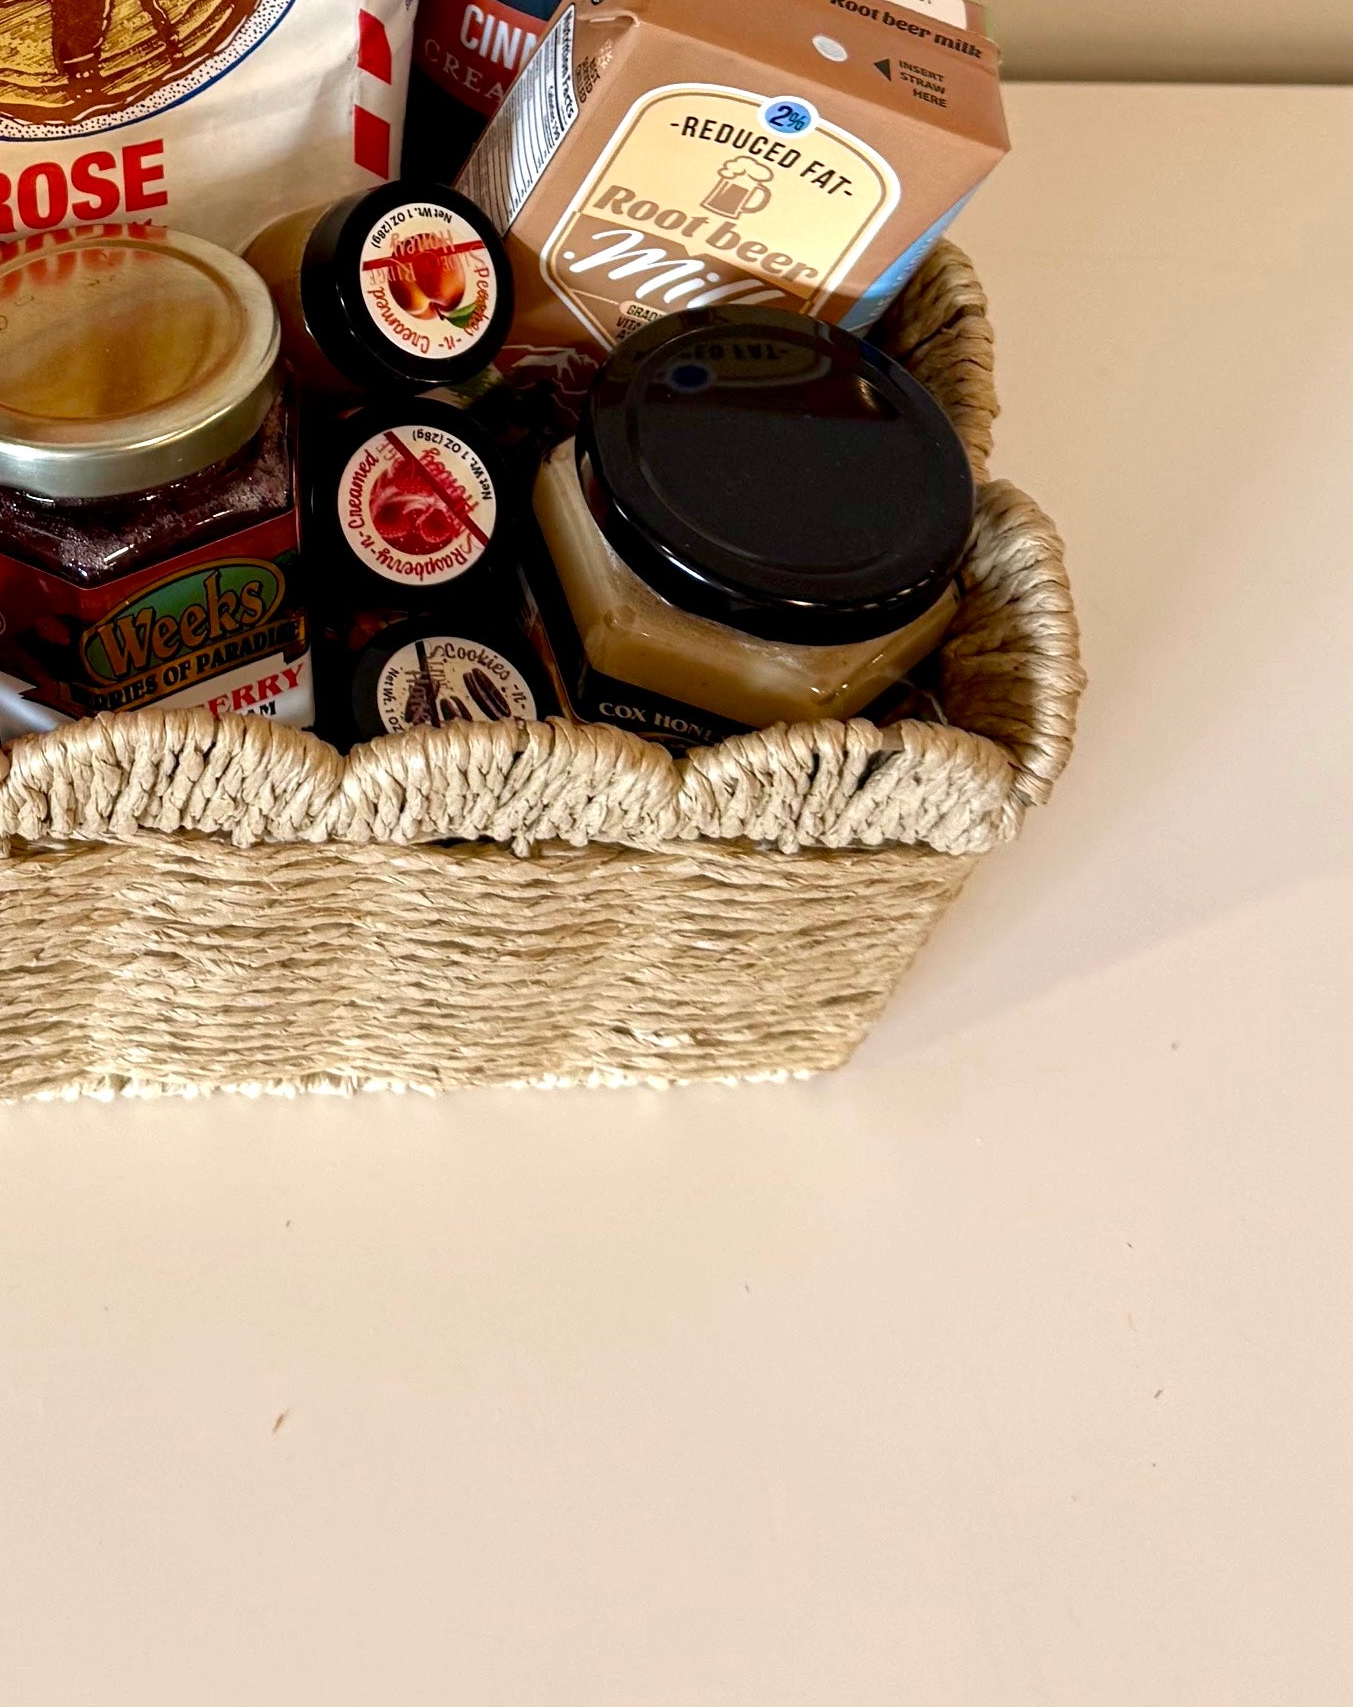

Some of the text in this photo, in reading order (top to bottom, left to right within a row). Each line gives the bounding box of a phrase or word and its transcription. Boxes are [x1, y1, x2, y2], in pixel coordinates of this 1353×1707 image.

[883, 10, 932, 39] beer
[935, 26, 982, 60] milk
[898, 60, 945, 83] INSERT
[899, 71, 946, 96] STRAW
[912, 87, 948, 108] HERE
[769, 105, 805, 131] 2%
[390, 211, 406, 227] OZ
[414, 207, 433, 218] Wt.
[432, 209, 453, 223] Net
[370, 220, 392, 249] (28g)
[592, 183, 818, 285] Root beer
[367, 289, 431, 354] Creamed
[626, 304, 663, 322] GRAD
[412, 428, 444, 444] (28g)
[444, 437, 462, 453] OZ
[468, 458, 486, 481] Wt.
[478, 480, 492, 501] Net
[97, 569, 265, 679] Weeks
[163, 660, 195, 685] OF
[444, 642, 510, 681] Cookies
[202, 662, 307, 718] ERRY
[598, 702, 646, 723] COX
